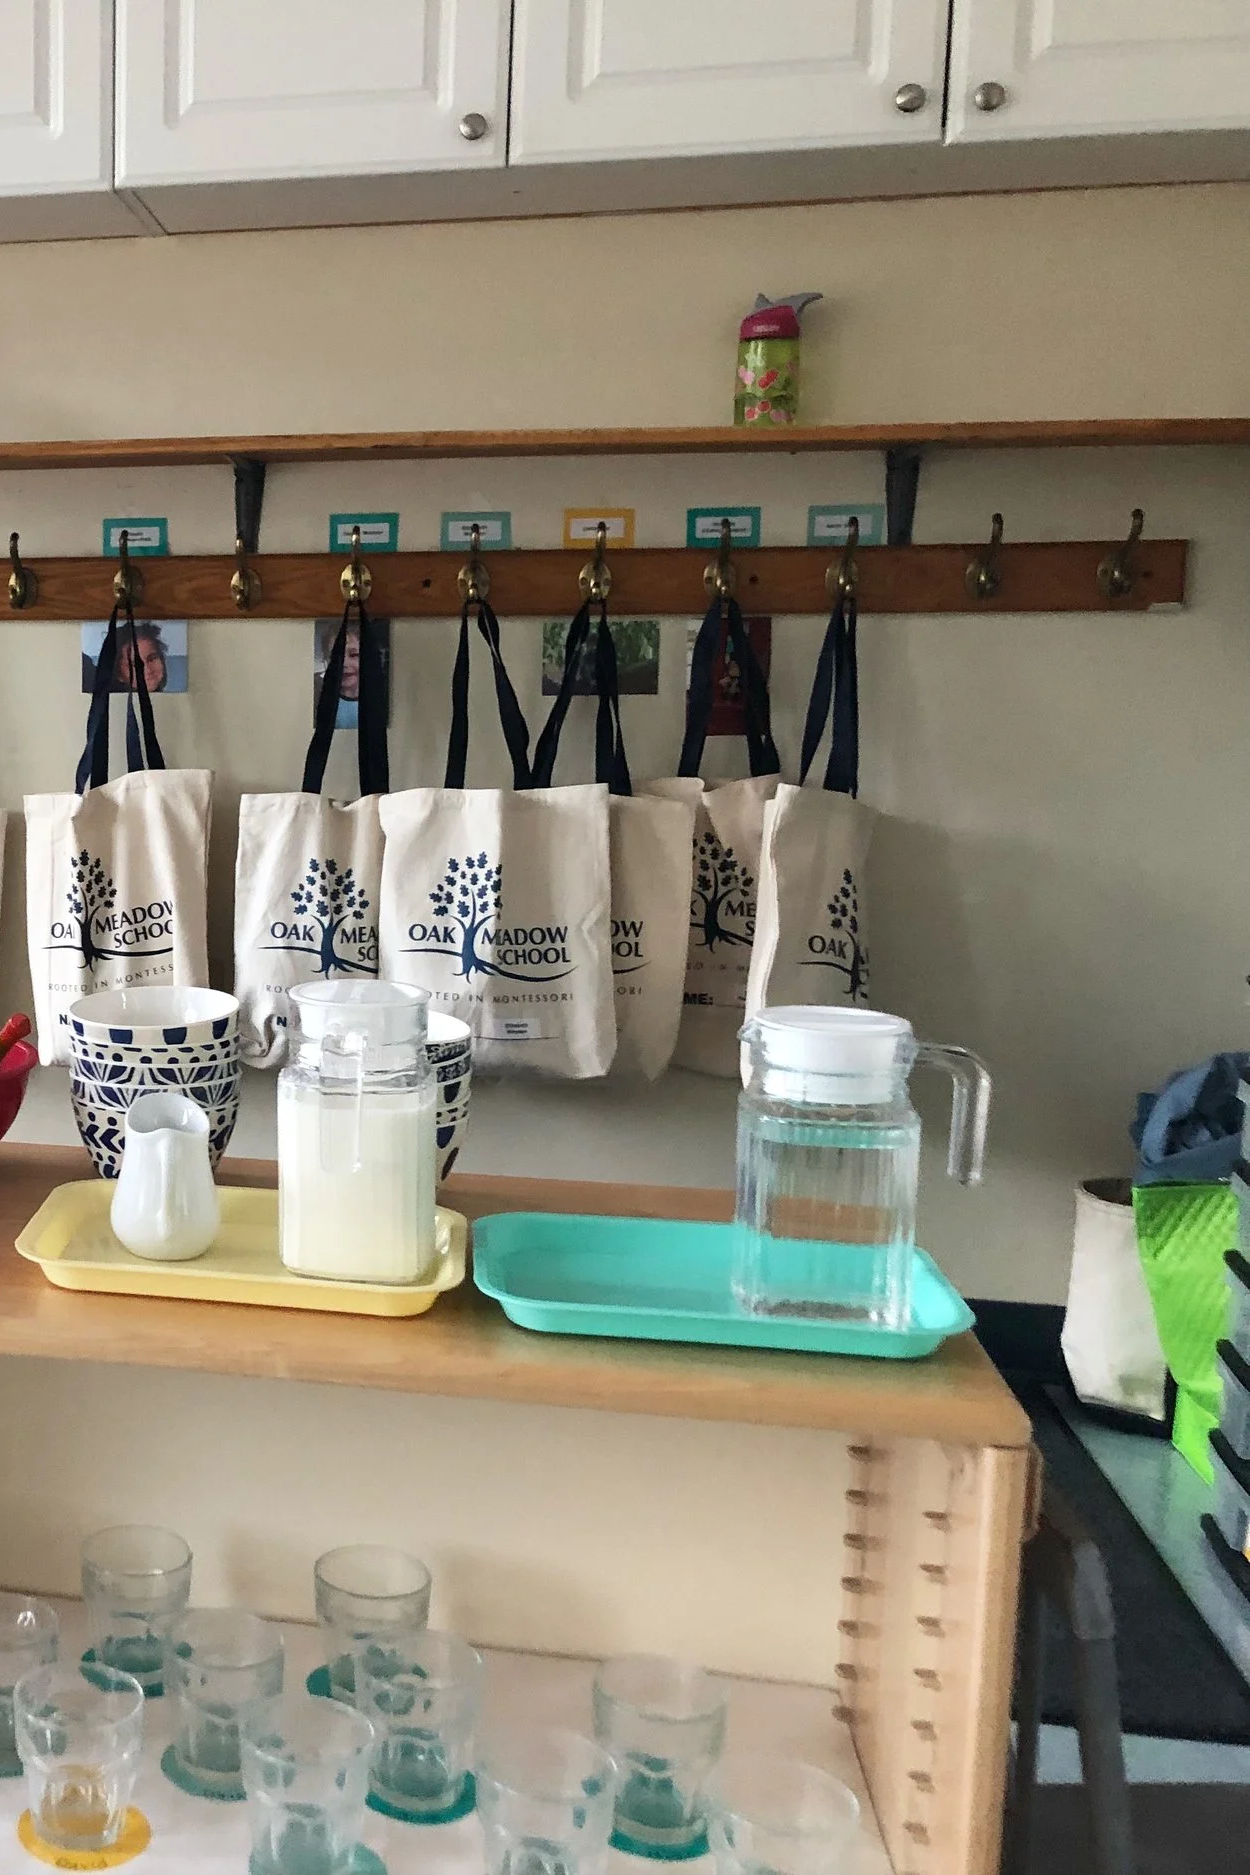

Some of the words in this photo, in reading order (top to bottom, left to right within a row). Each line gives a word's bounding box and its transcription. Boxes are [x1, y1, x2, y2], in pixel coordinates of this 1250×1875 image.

[51, 922, 75, 939] OA
[113, 919, 173, 948] SCHOO
[270, 922, 315, 942] OAK
[340, 926, 379, 944] MEA
[408, 923, 456, 944] OAK
[481, 926, 568, 946] MADOW
[808, 935, 848, 959] OAK
[48, 982, 88, 993] ROOTED
[94, 980, 109, 990] IN
[115, 963, 174, 985] MONTESS
[427, 991, 460, 1001] TED
[468, 994, 485, 1003] IN
[493, 993, 574, 1004] MONTESSORI
[683, 993, 714, 1006] ME:
